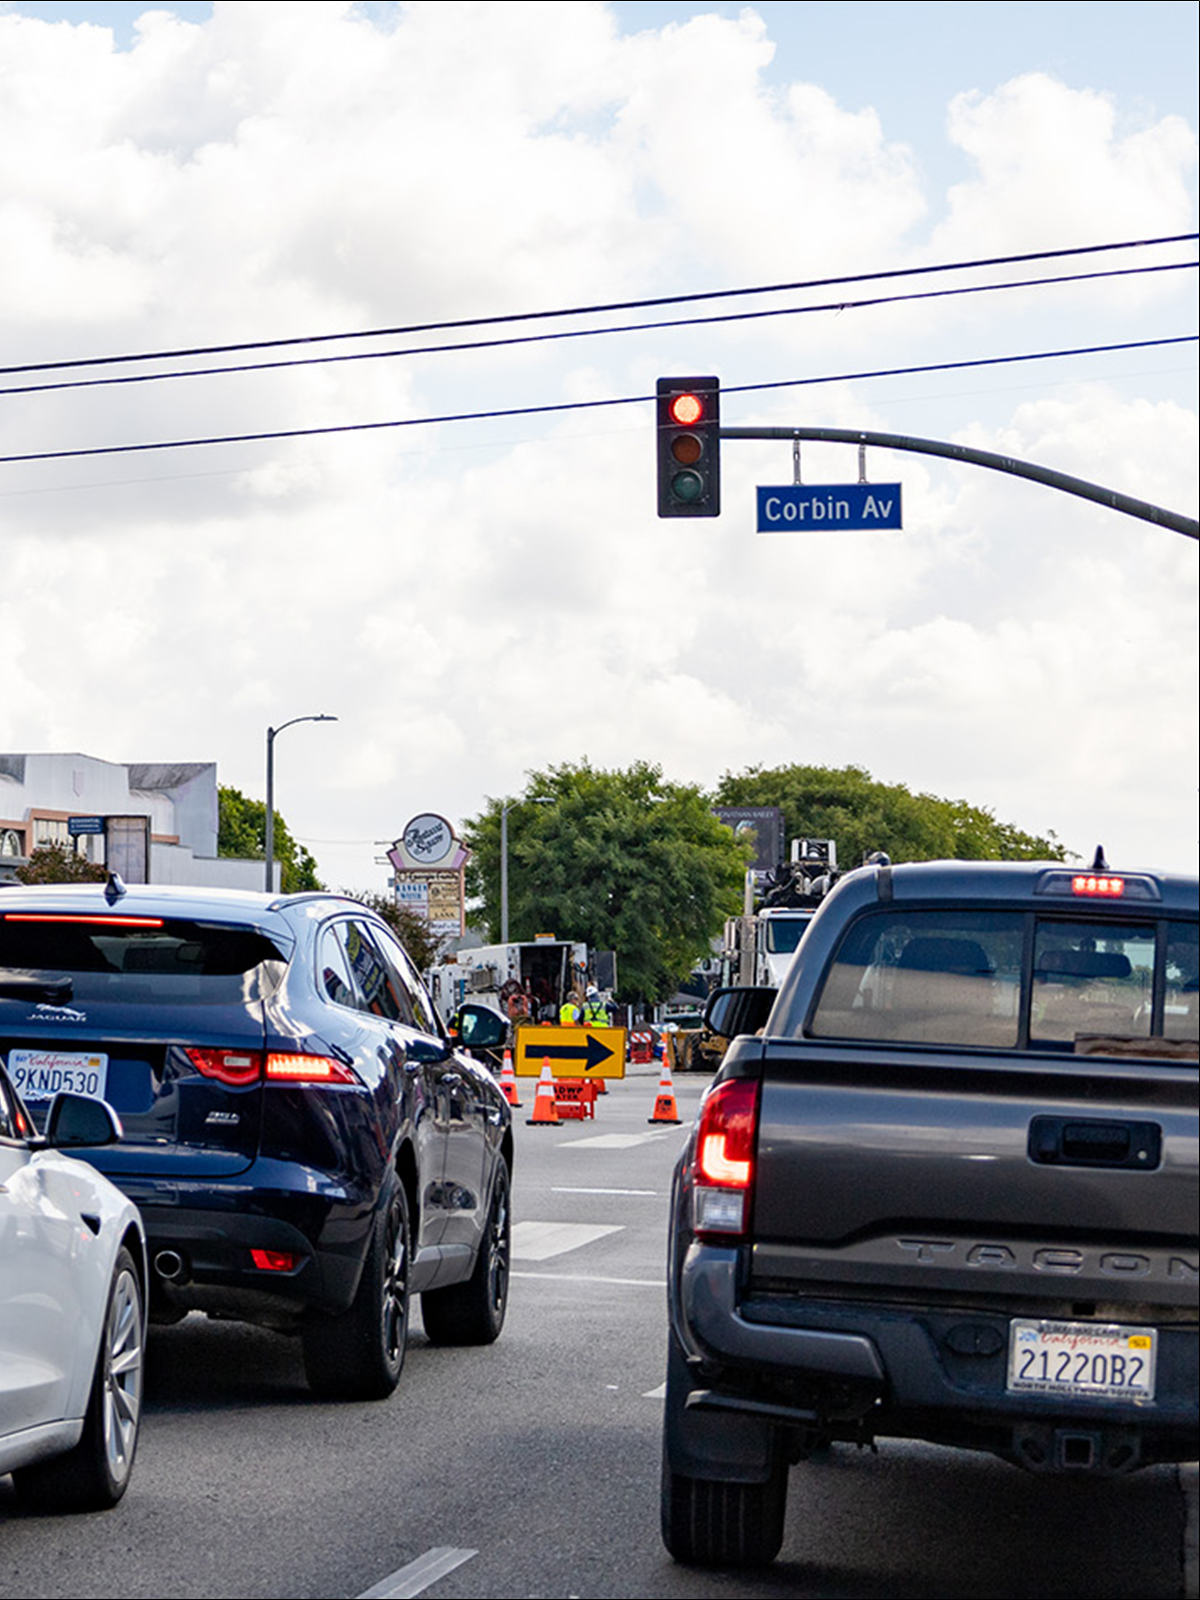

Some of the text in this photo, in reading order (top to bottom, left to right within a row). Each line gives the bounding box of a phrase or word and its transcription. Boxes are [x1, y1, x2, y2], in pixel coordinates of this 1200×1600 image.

[765, 495, 893, 521] Corbin Av
[26, 1013, 86, 1022] JAGUAR
[29, 1054, 89, 1069] California
[15, 1068, 98, 1095] 9KND530
[1041, 1332, 1124, 1350] California
[1018, 1348, 1144, 1389] 21220B2
[1013, 1381, 1047, 1390] NORTH
